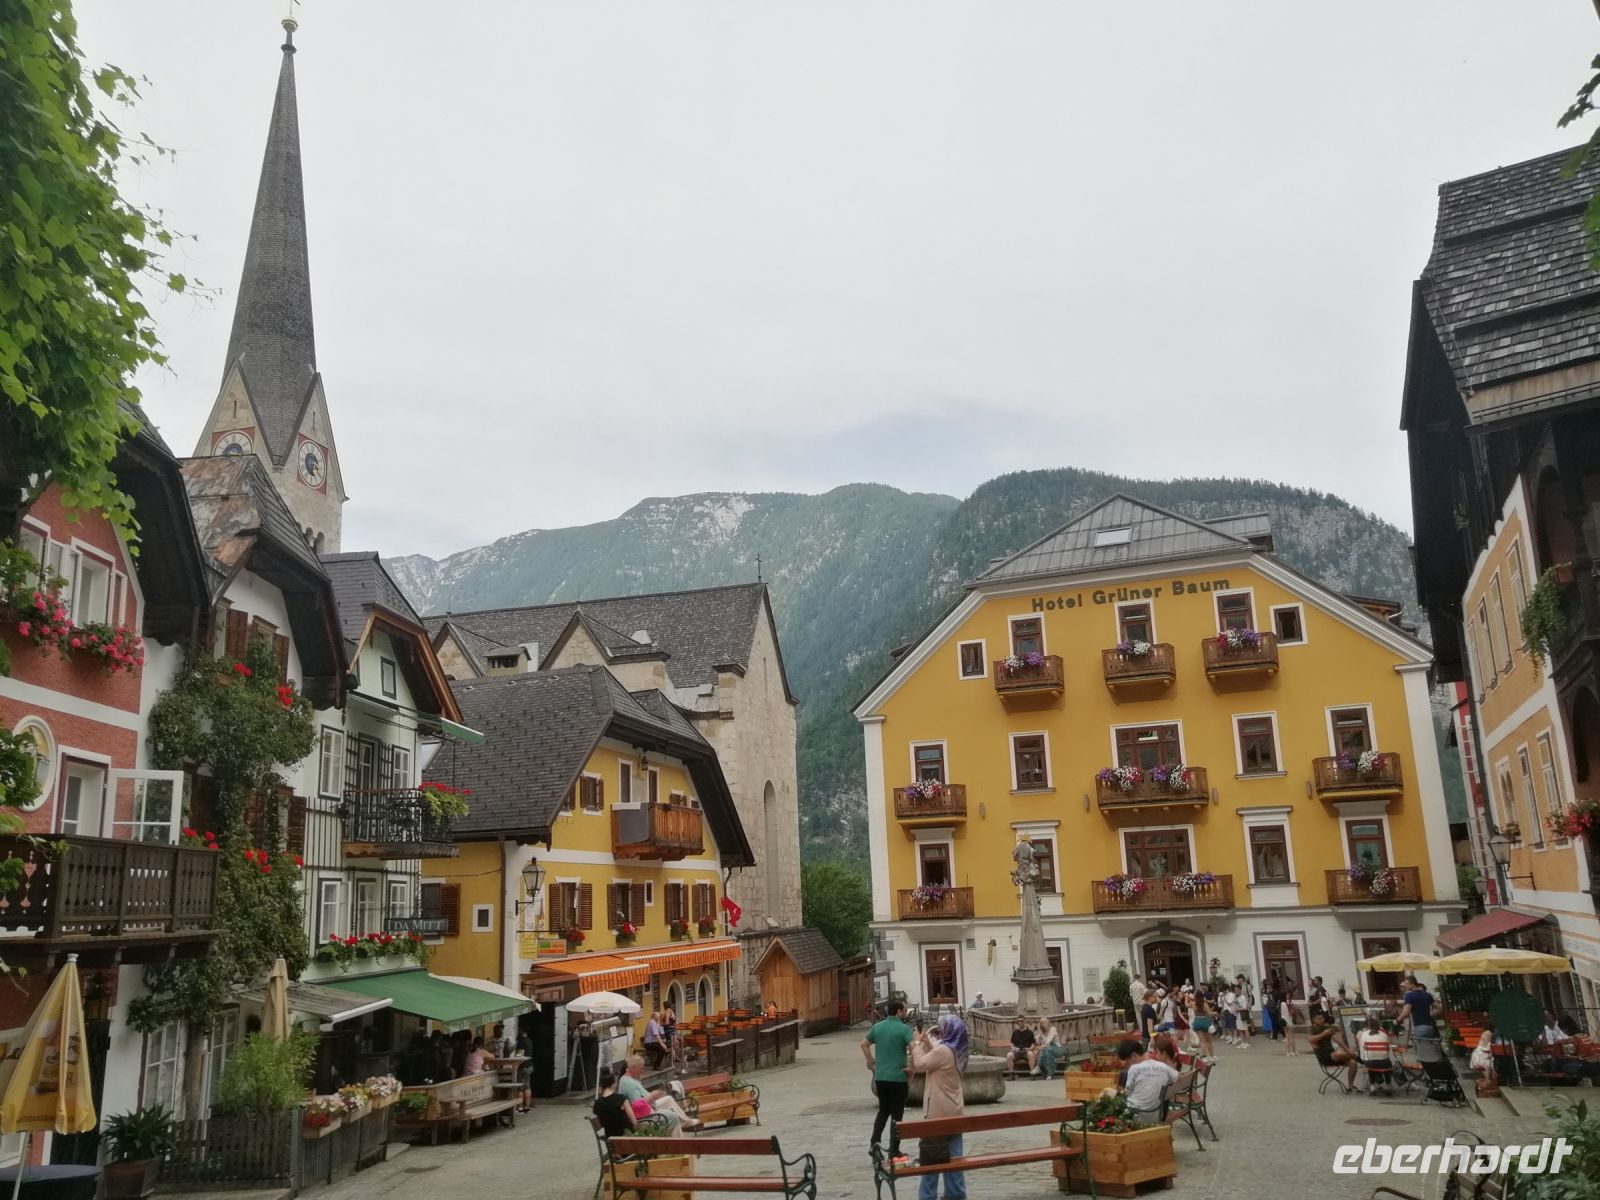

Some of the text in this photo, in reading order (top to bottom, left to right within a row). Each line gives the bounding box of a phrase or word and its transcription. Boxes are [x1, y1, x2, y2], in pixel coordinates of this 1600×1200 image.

[1031, 578, 1230, 612] Hotel Grüner Baum
